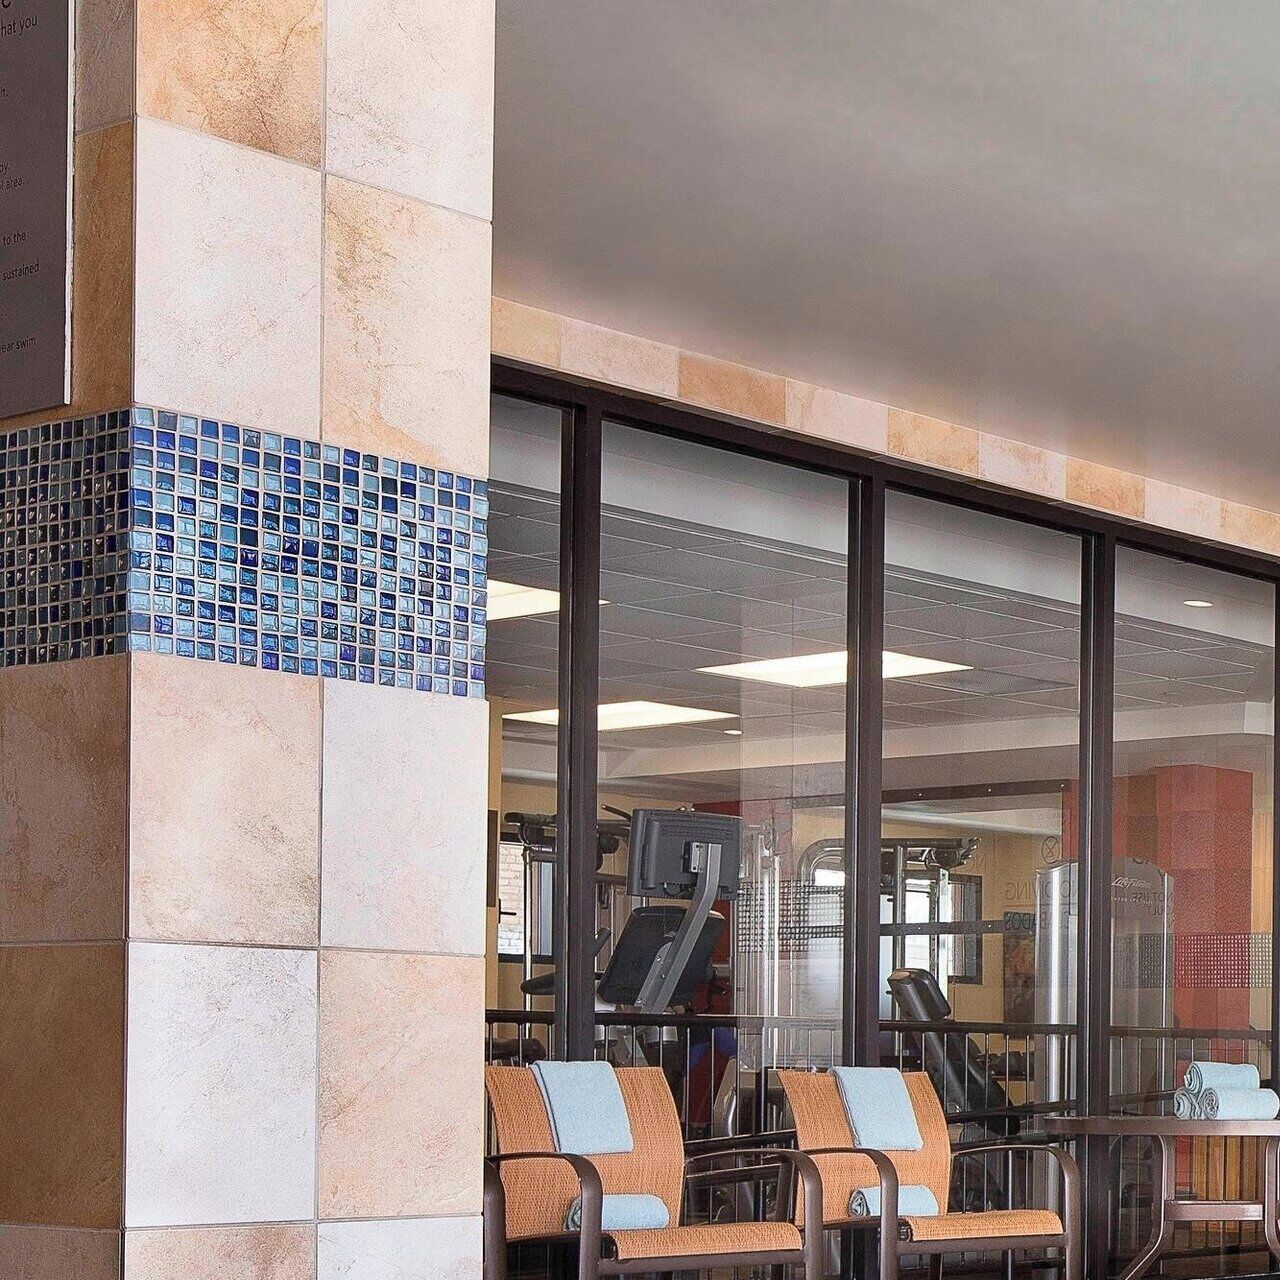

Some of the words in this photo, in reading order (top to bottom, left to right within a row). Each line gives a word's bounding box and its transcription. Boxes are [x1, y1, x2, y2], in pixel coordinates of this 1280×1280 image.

[20, 15, 38, 36] you
[3, 235, 11, 247] to
[2, 261, 40, 281] sustained
[16, 335, 37, 351] swim
